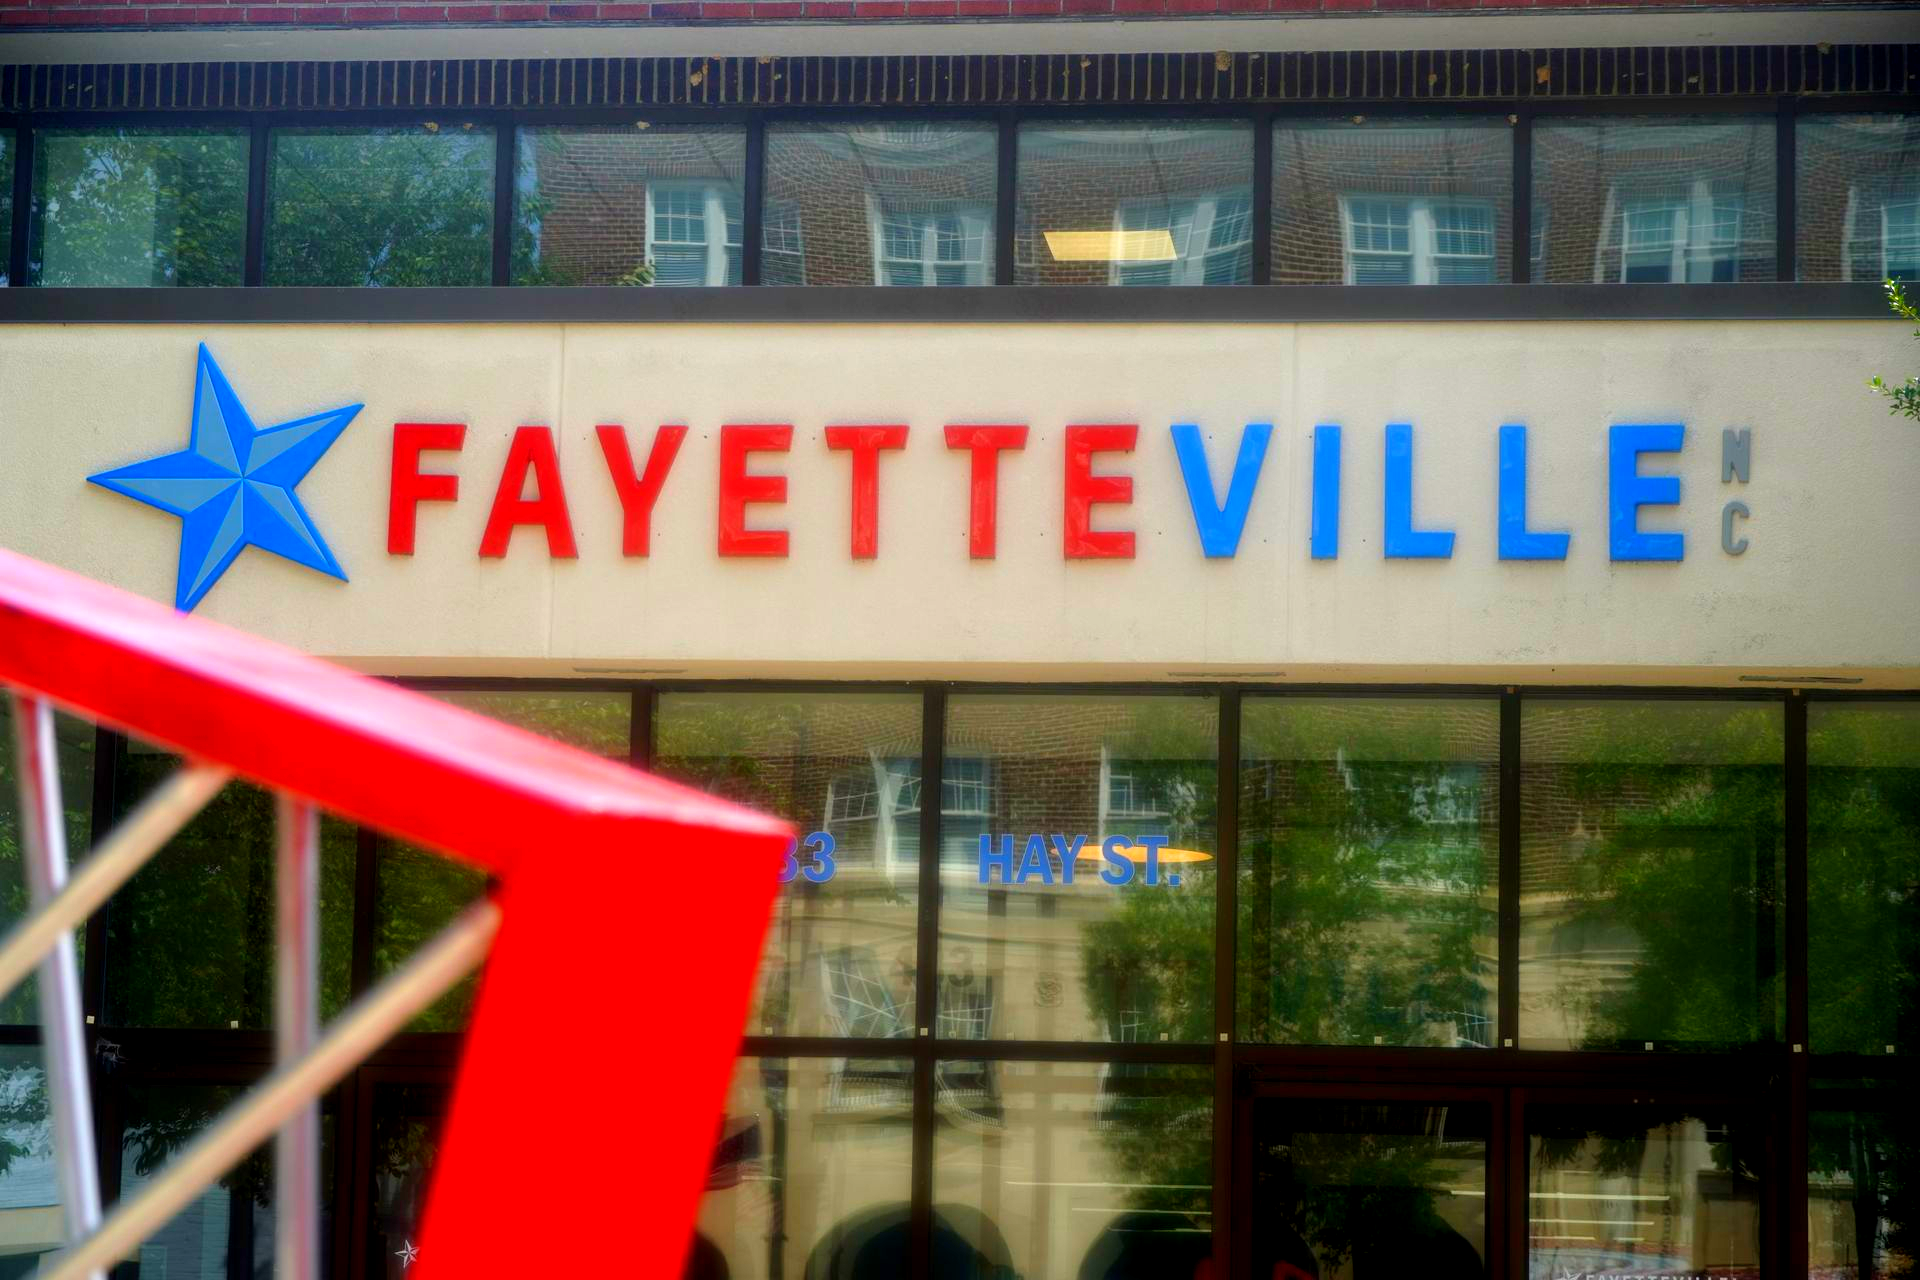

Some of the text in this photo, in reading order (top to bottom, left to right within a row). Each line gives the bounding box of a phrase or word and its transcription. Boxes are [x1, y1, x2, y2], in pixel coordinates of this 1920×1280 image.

[388, 422, 1686, 562] FAYETTEVILLE
[978, 833, 1088, 885] HAY
[1100, 834, 1182, 887] ST.
